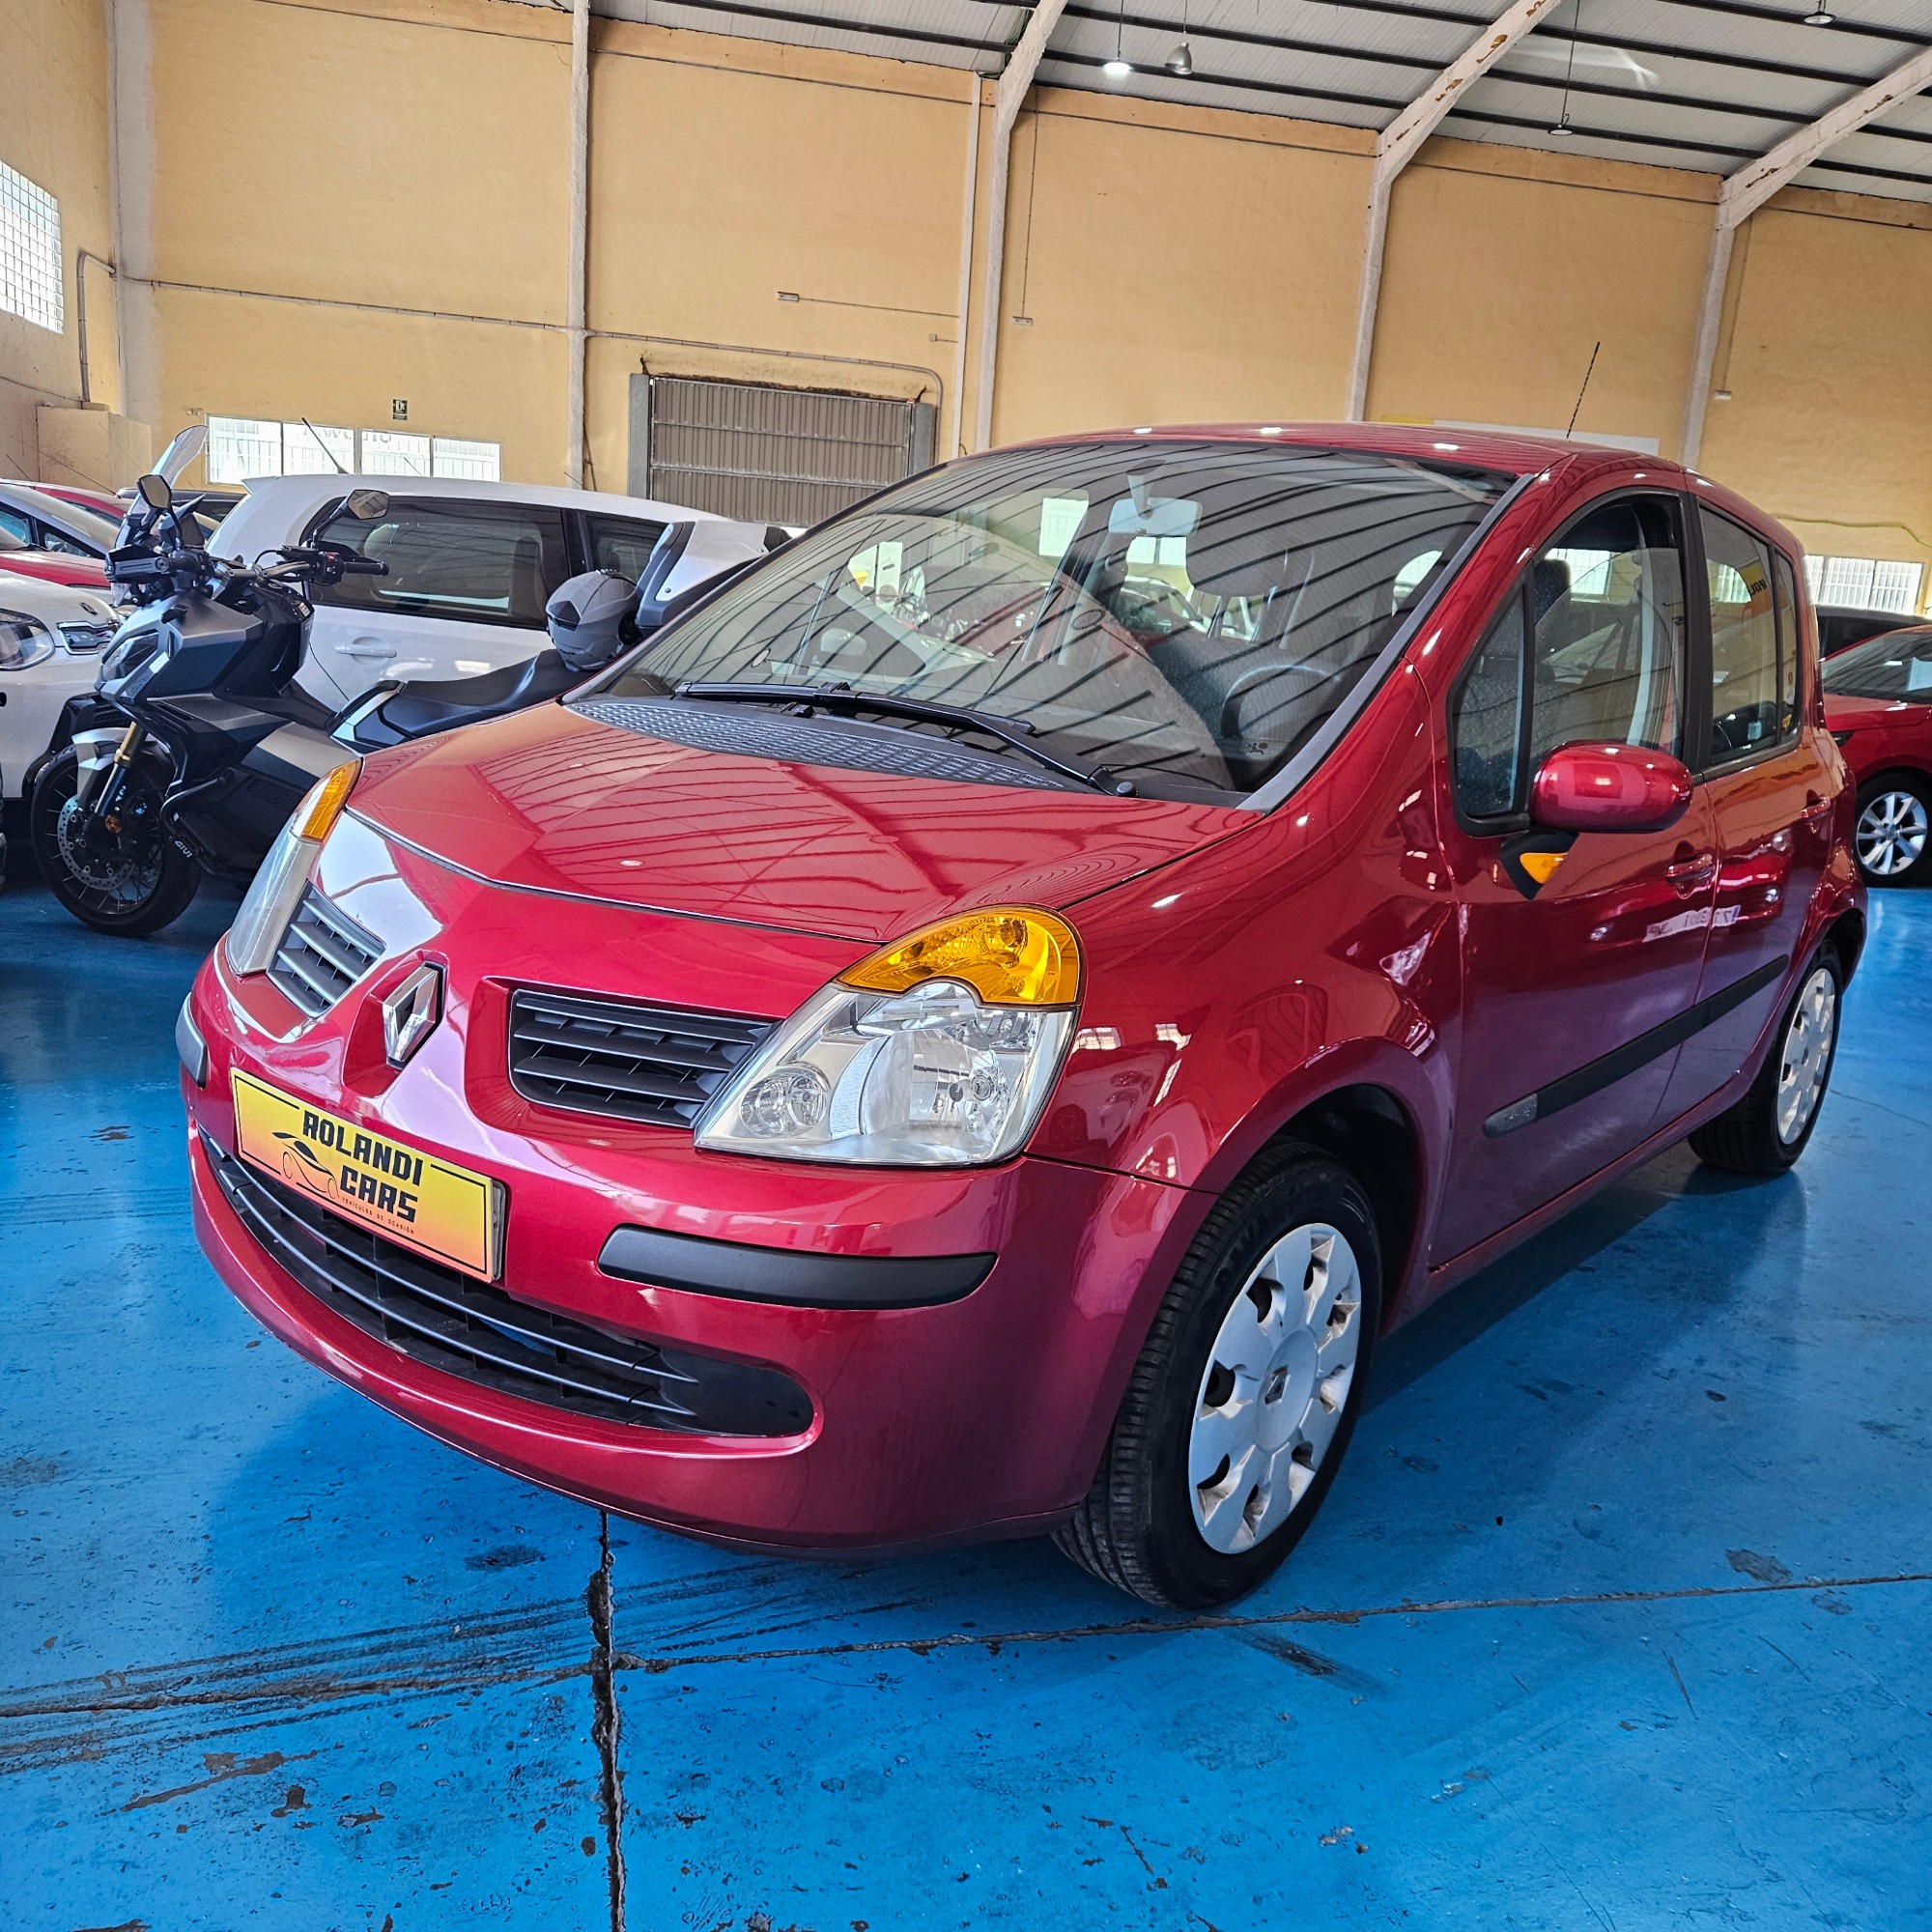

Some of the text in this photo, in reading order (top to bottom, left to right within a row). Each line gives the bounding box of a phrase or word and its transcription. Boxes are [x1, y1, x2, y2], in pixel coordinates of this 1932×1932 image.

[174, 840, 193, 859] GIVI
[302, 1109, 424, 1187] ROLANDI
[339, 1164, 419, 1224] CARS
